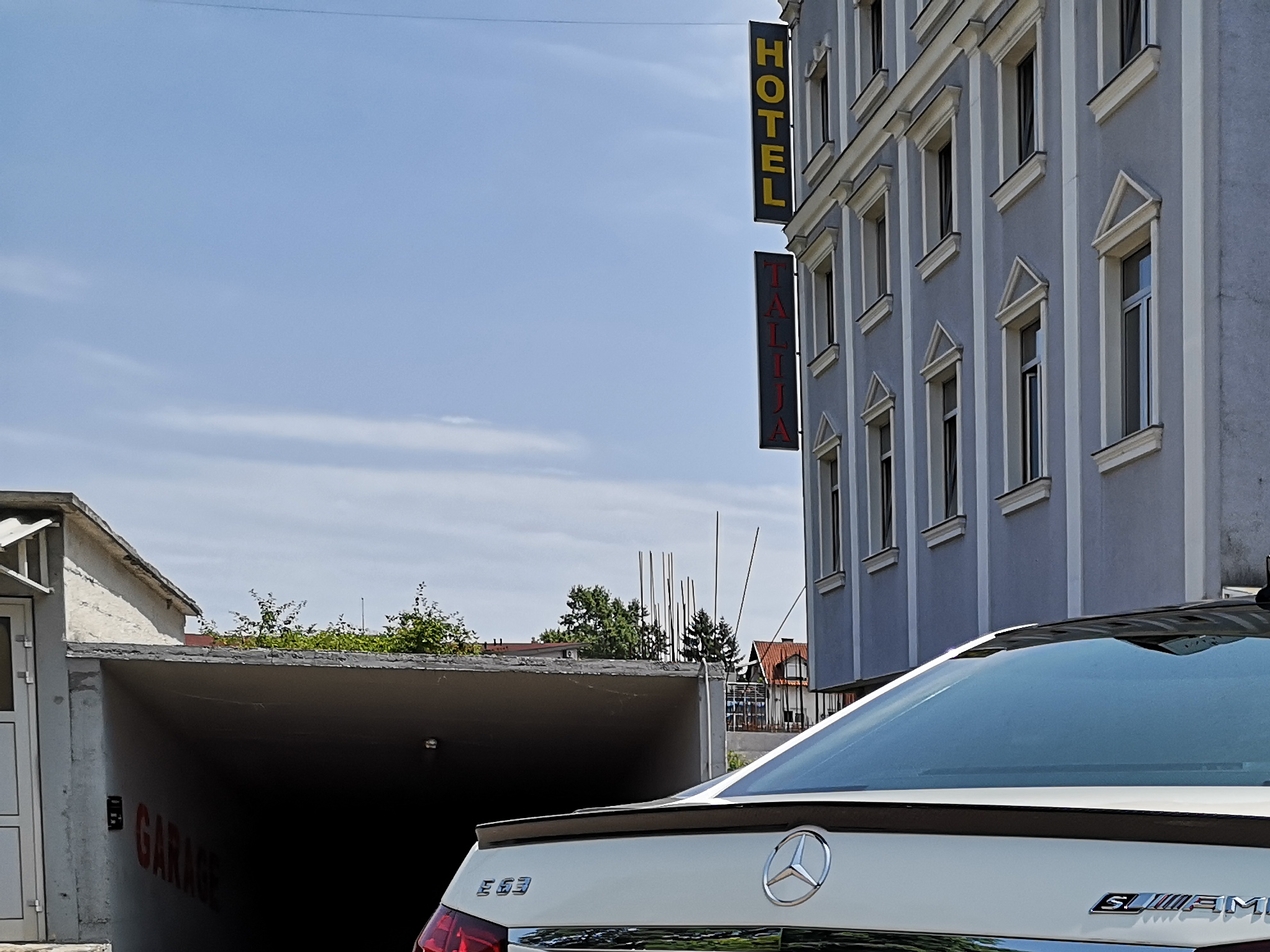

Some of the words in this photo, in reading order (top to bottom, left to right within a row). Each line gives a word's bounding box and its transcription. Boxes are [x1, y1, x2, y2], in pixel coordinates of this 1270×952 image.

[756, 37, 787, 208] HOTEL
[763, 260, 792, 443] TALIJA
[135, 802, 220, 914] GARAGE
[476, 878, 496, 897] E
[496, 876, 532, 896] 63
